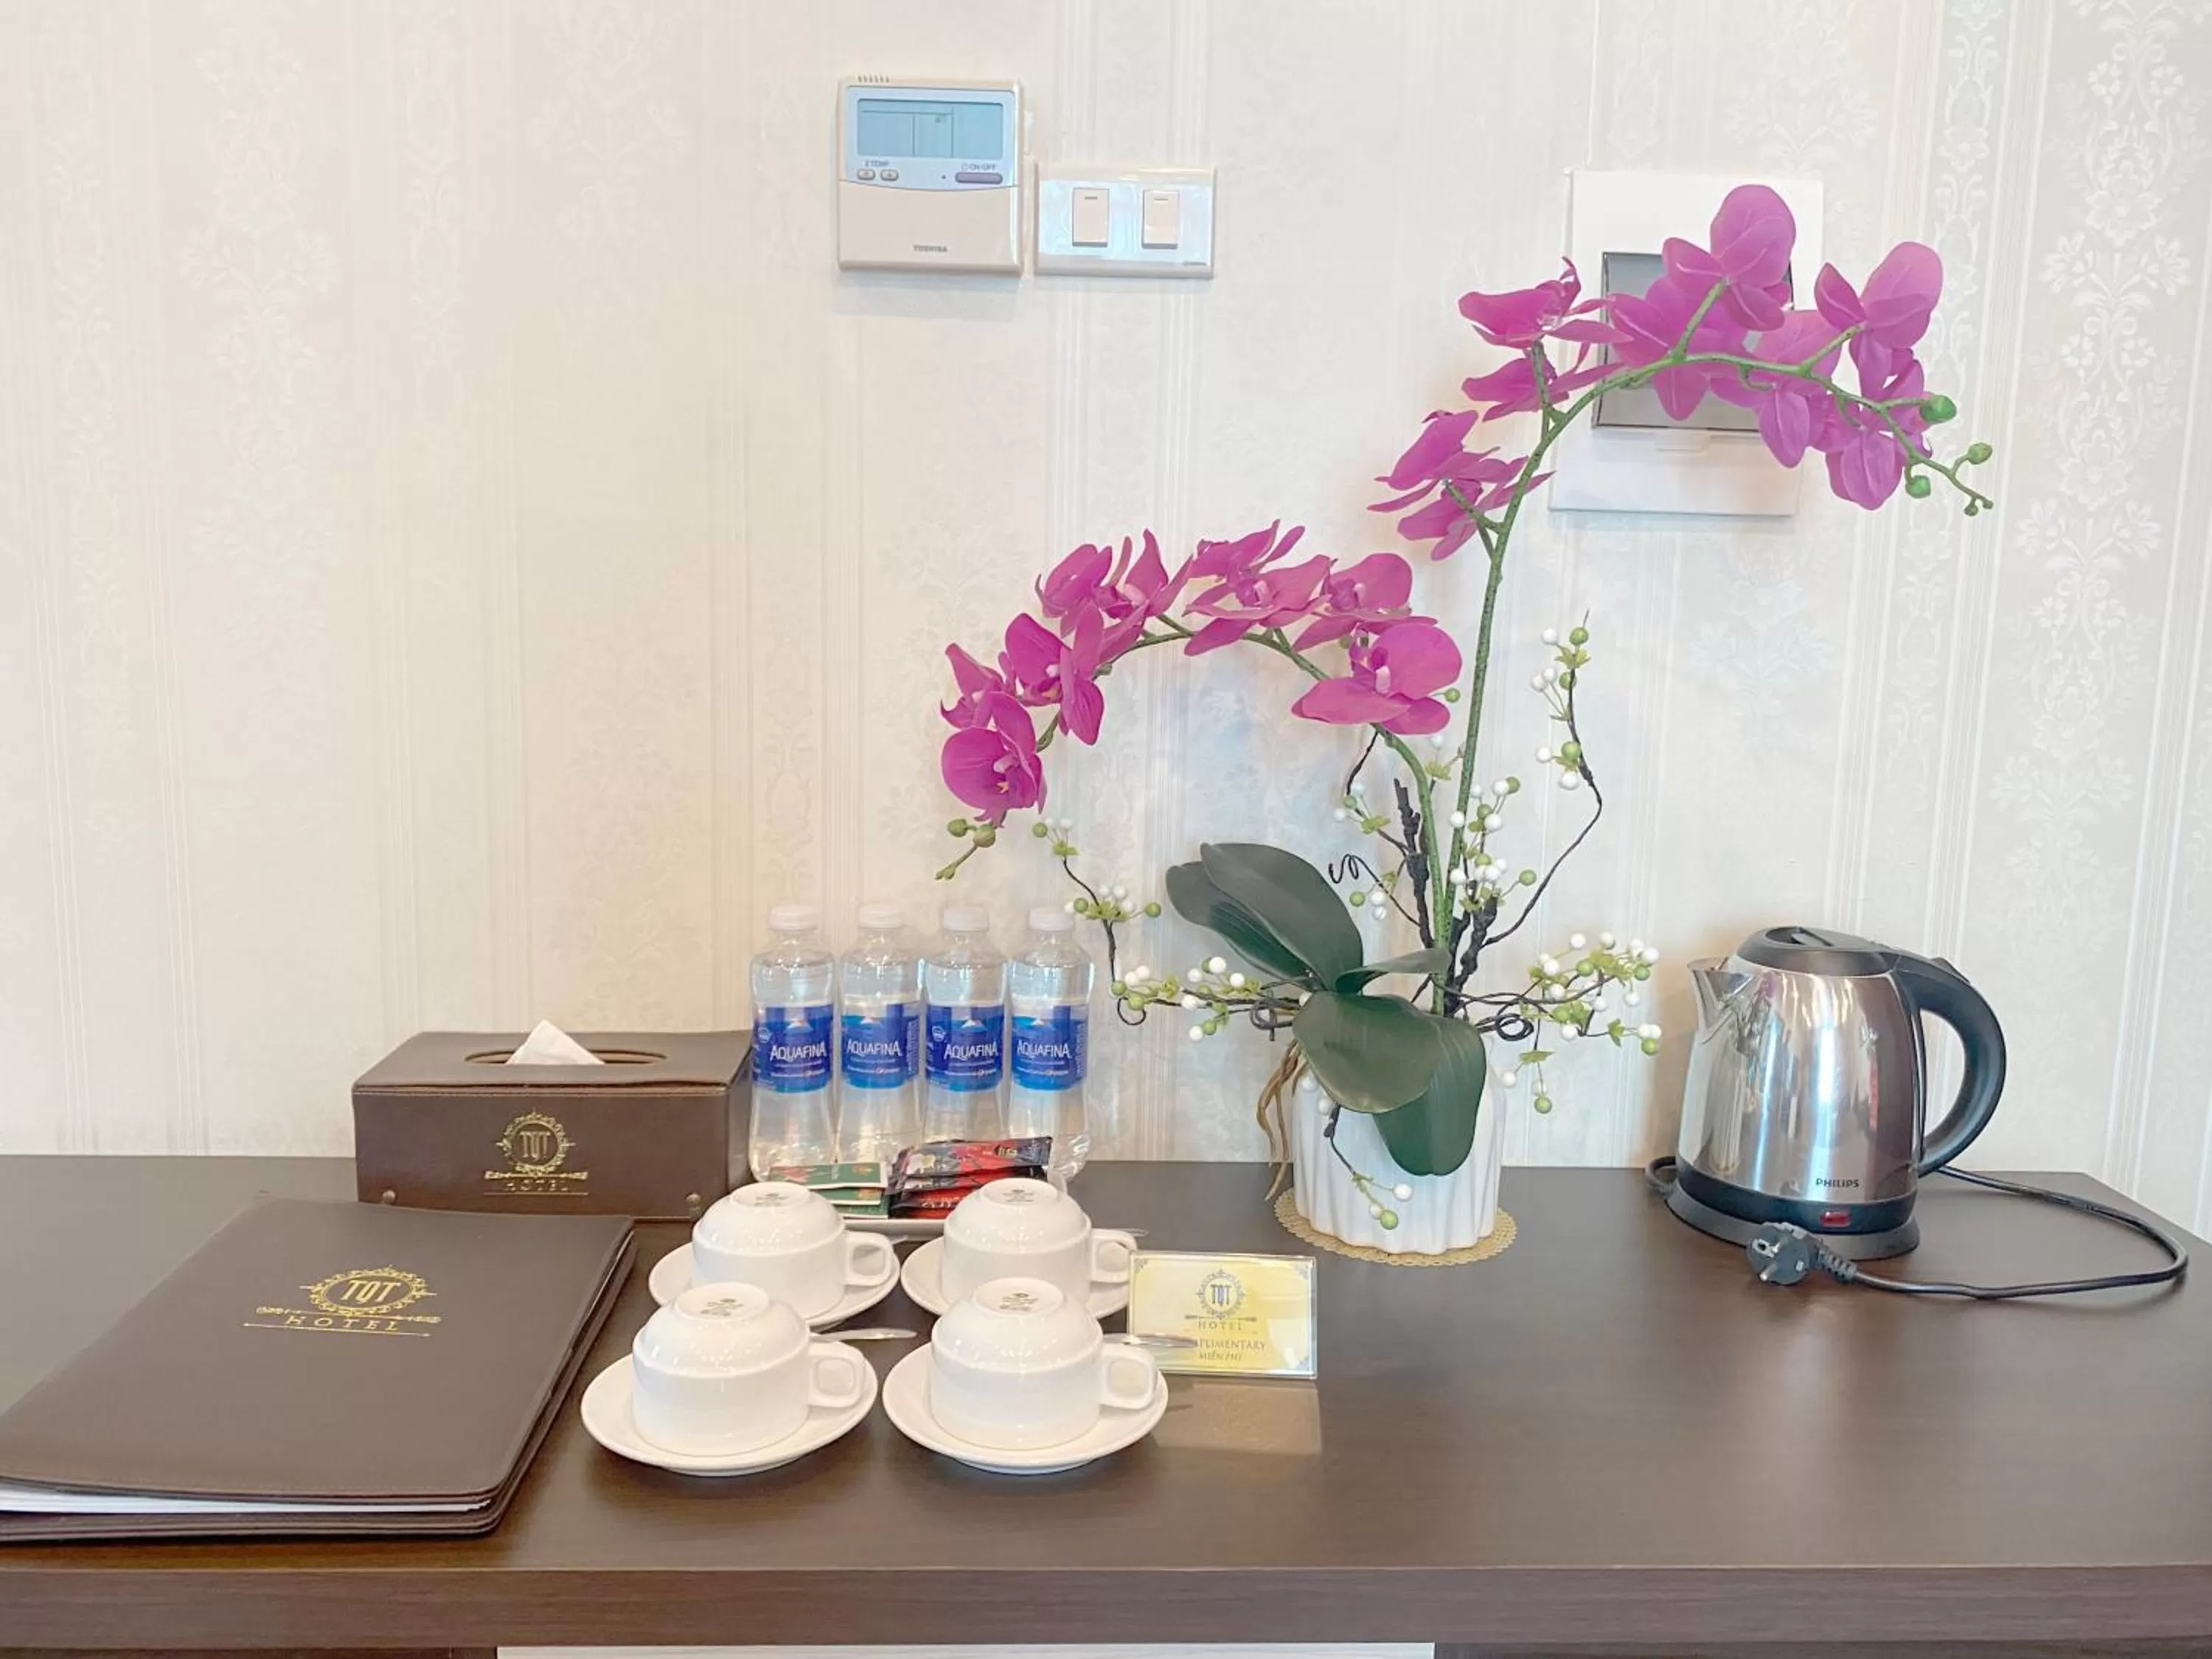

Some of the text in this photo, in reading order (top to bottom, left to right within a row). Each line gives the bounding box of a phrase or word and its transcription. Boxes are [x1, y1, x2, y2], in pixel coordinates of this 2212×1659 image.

[913, 244, 947, 254] TOSHIBA
[769, 1040, 827, 1062] AQUAFINA
[847, 1037, 903, 1057] AQUAFINA
[943, 1039, 999, 1061] AQUAFINA
[1016, 1038, 1072, 1059] AQUAFINA
[1816, 1178, 1860, 1189] PHILIPS
[282, 1315, 401, 1332] HOTEL
[1197, 1320, 1243, 1331] HOTEL
